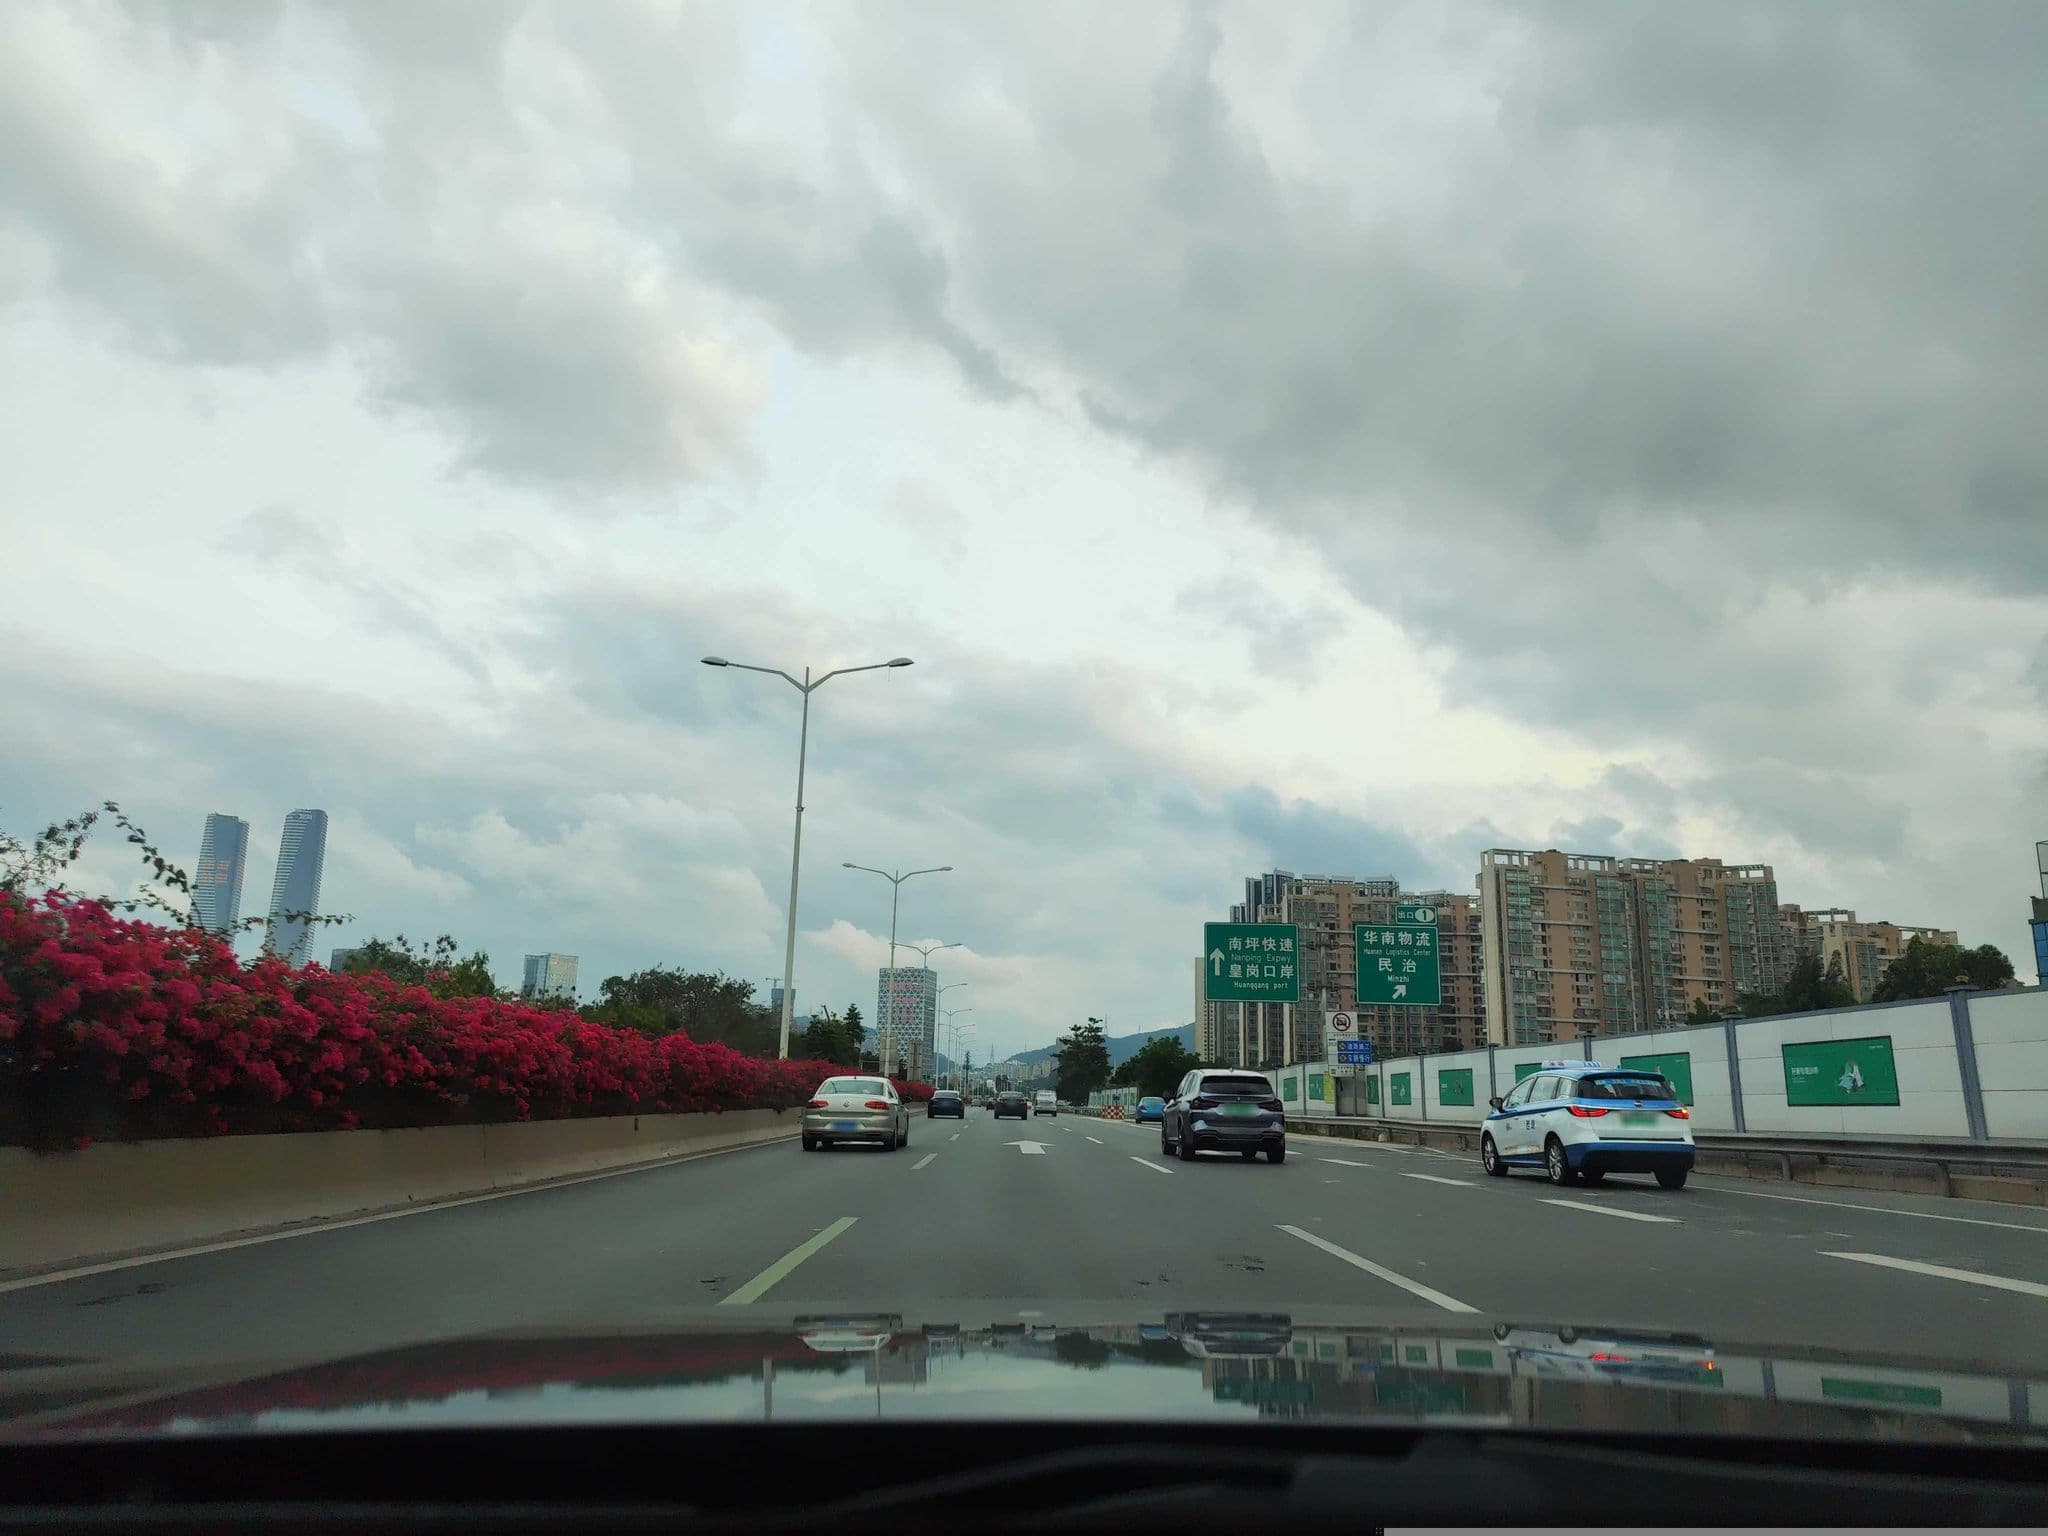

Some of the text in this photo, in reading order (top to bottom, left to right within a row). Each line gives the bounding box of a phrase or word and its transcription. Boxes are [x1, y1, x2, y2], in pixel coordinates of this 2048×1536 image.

[1398, 909, 1427, 921] 出口 1
[1228, 936, 1295, 952] 南坪快速
[1363, 930, 1431, 947] 华南物流
[1231, 953, 1262, 963] Nanping
[1378, 957, 1417, 973] 民治
[1228, 963, 1294, 979] 皇岗口岸
[1233, 980, 1288, 990] Huanggang port
[1387, 974, 1410, 983] Minzhi
